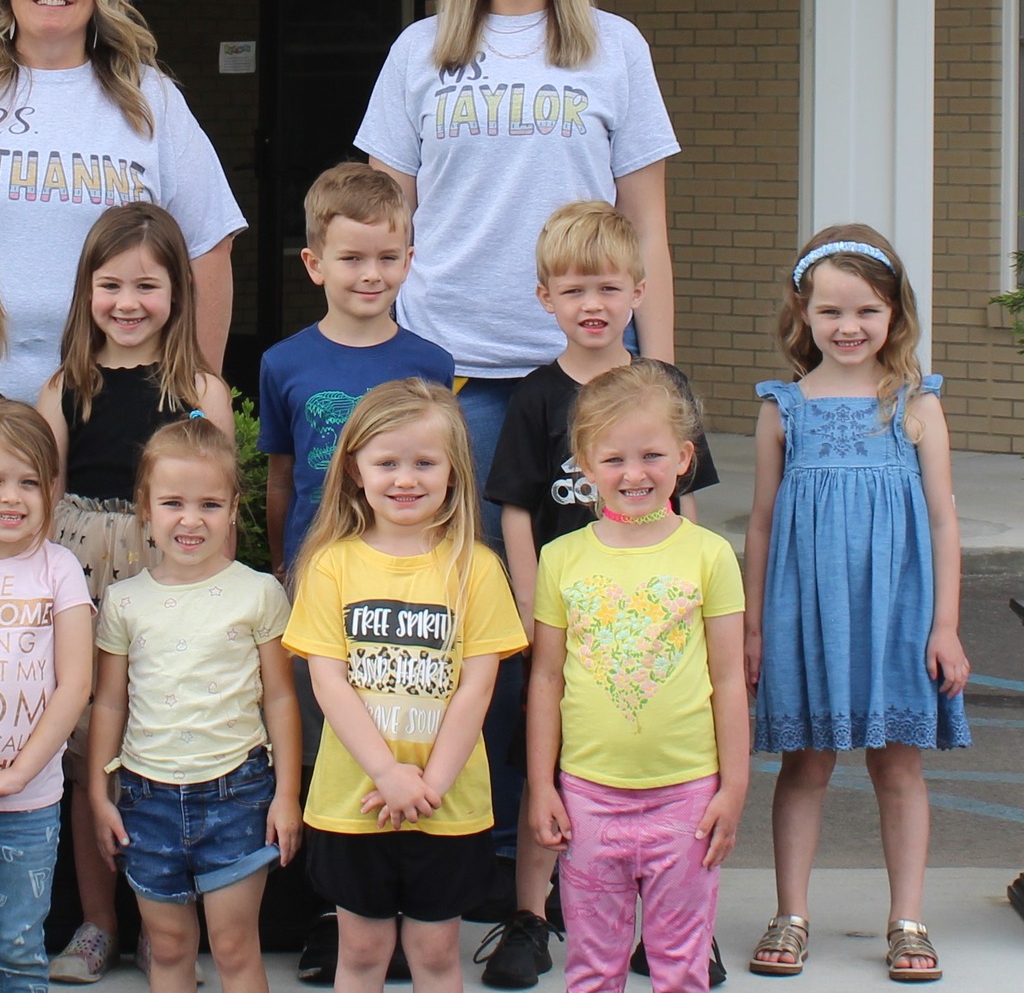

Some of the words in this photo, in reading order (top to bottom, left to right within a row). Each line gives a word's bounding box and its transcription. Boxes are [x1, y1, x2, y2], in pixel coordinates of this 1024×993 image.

[434, 83, 589, 139] TAYLOR
[351, 605, 392, 637] FREE
[395, 608, 450, 641] SPIRIT
[16, 659, 47, 682] MY
[351, 655, 388, 686] KIND
[395, 655, 449, 688] HEART
